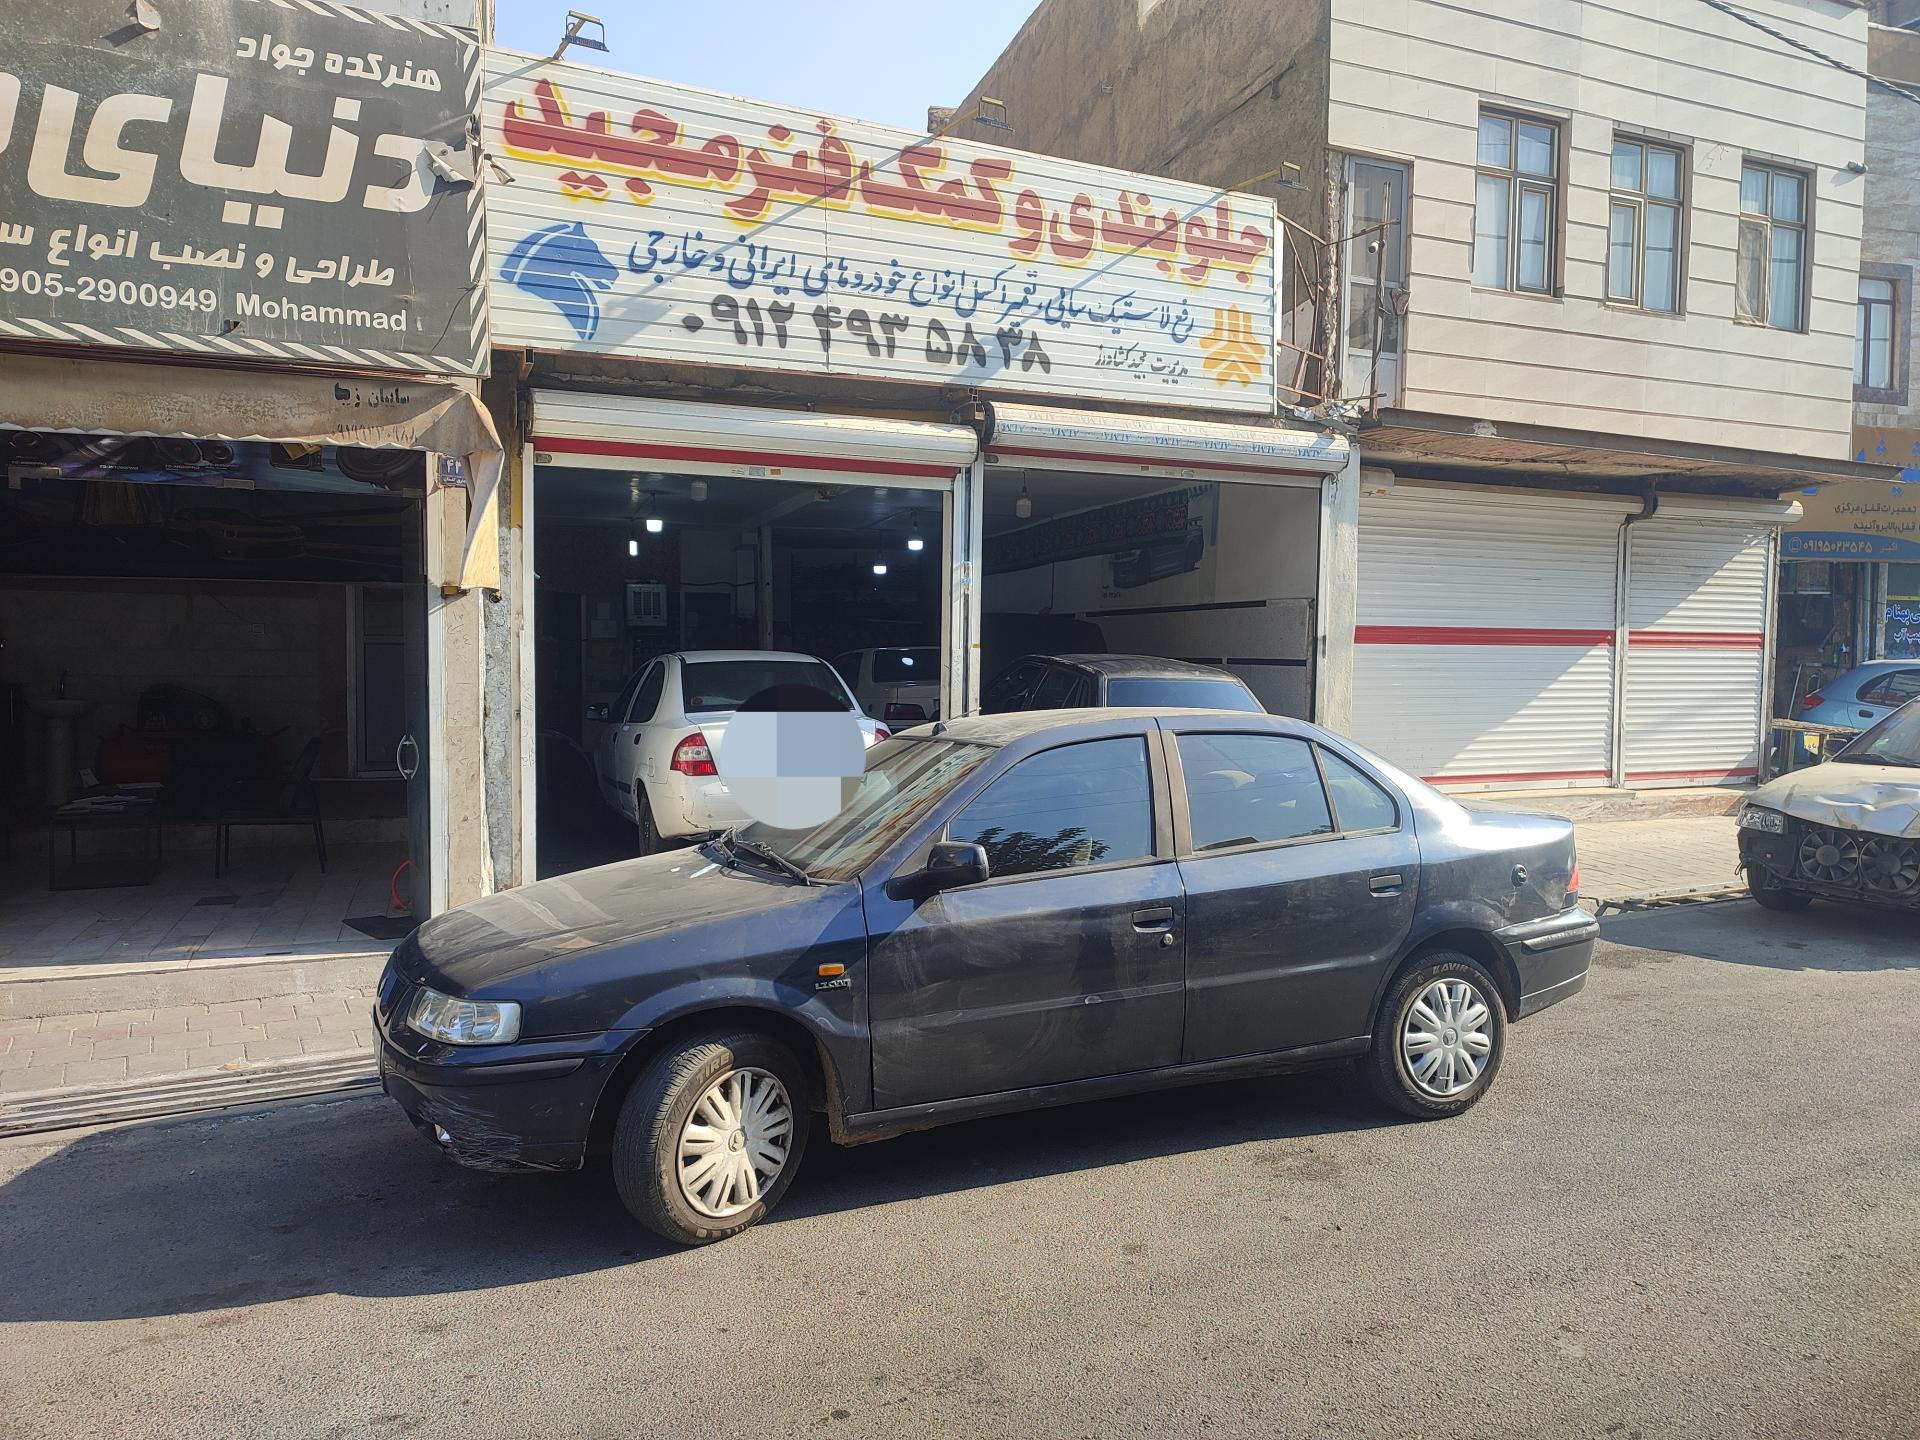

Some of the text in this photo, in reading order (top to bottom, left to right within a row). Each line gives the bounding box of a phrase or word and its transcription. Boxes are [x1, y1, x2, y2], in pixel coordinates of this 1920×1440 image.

[237, 34, 442, 91] هنرکده جواد
[28, 73, 438, 229] دنیای
[724, 119, 853, 226] فنر
[860, 145, 1013, 231] کمک
[48, 224, 138, 266] انواع
[149, 240, 246, 270] نصب
[255, 252, 273, 278] و
[286, 255, 394, 286] طراحی
[0, 268, 406, 332] 905-2900949 Mohammad
